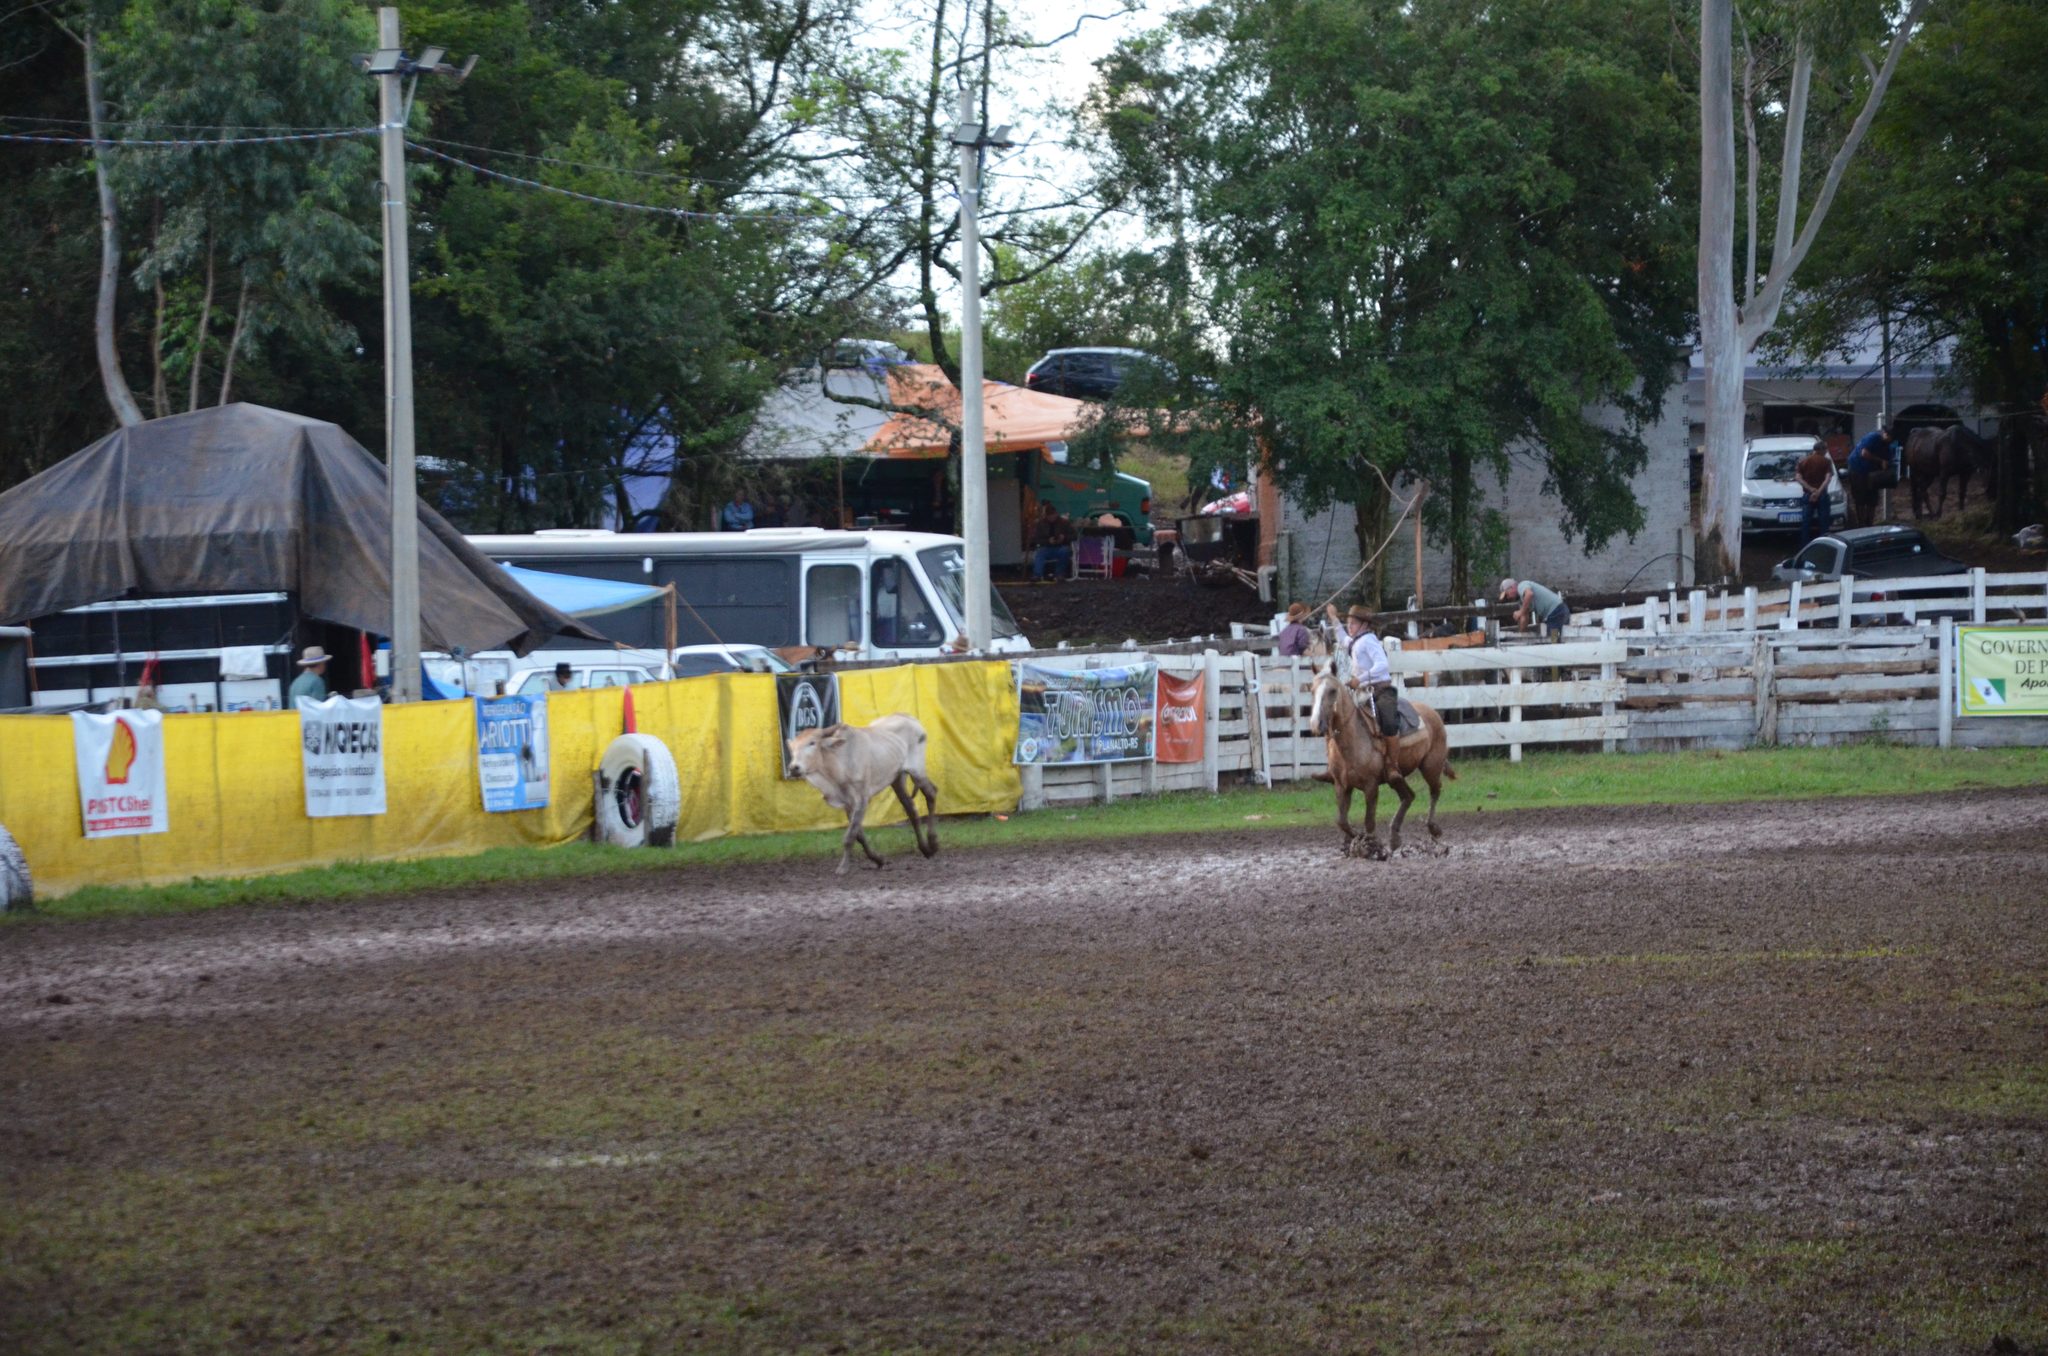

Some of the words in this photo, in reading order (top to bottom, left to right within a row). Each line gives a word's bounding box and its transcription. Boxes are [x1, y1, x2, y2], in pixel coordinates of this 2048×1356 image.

[1981, 639, 2048, 655] GOVERN
[2015, 660, 2036, 674] DE
[2021, 678, 2048, 690] Apo
[1044, 687, 1141, 739] TURISMO
